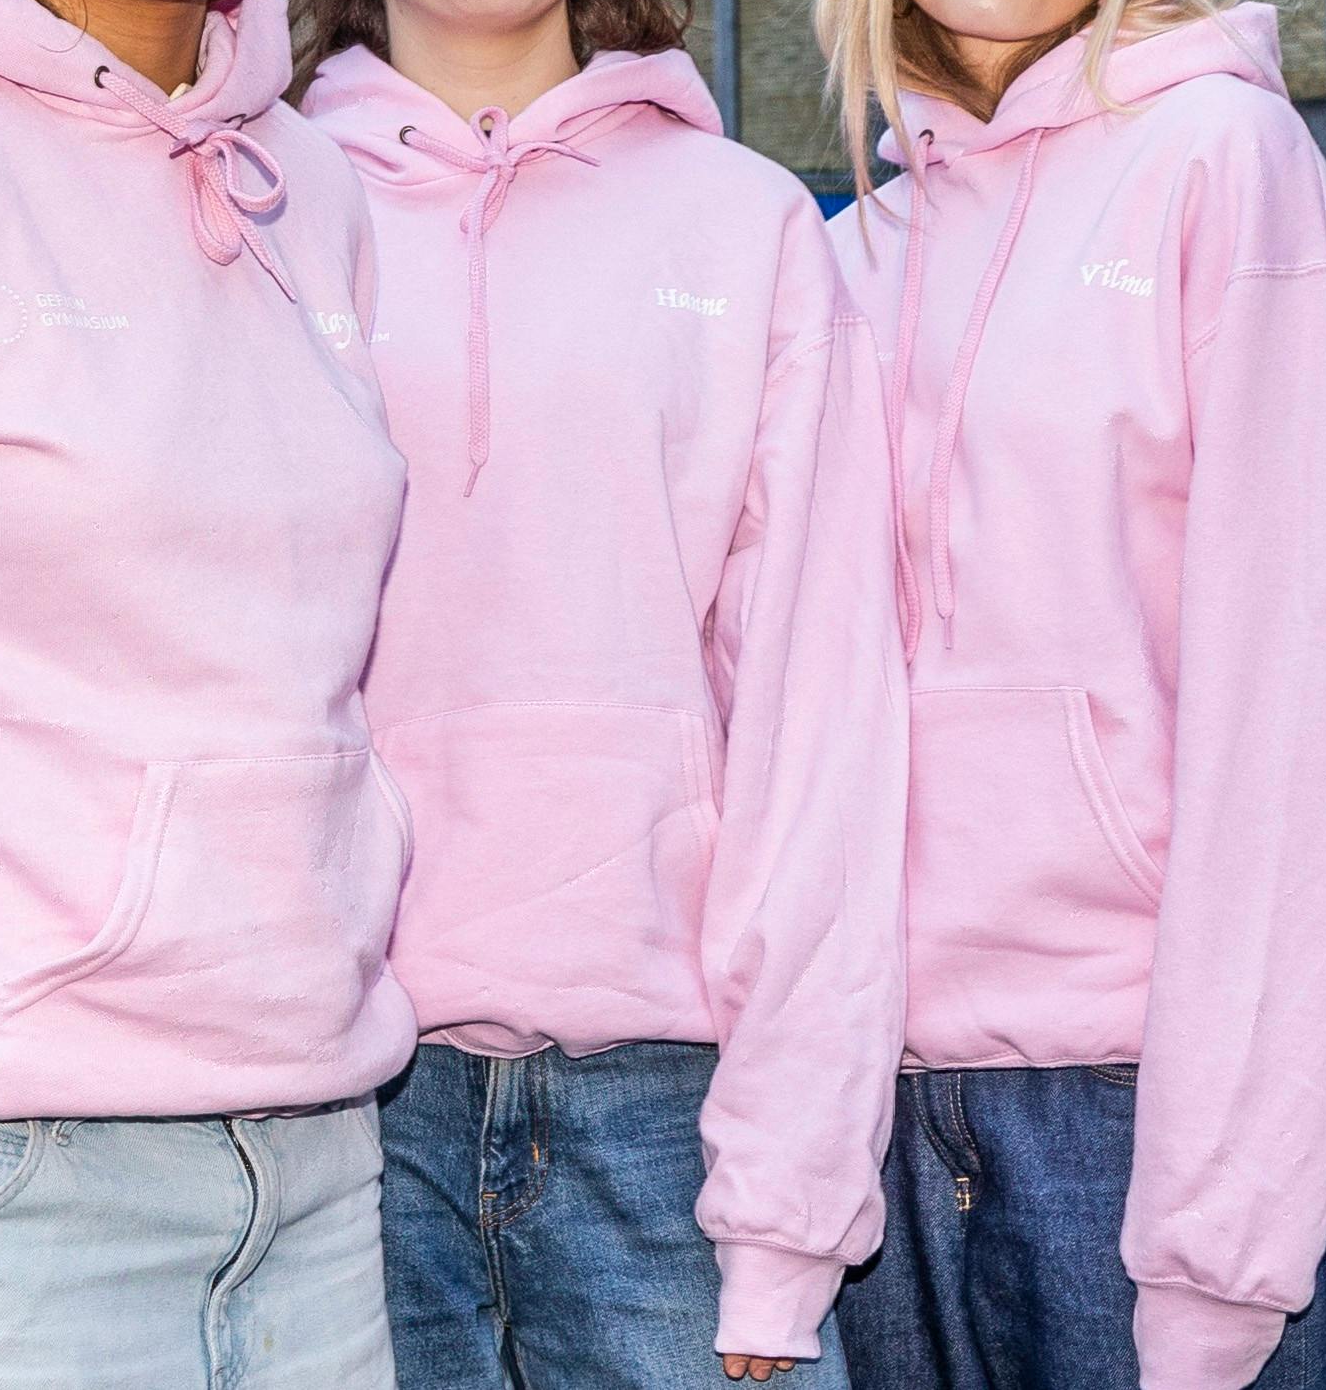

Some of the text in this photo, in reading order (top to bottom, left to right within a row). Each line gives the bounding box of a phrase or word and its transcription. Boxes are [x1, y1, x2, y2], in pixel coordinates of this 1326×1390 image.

[1079, 258, 1154, 298] Vilma
[655, 288, 728, 316] Hanne
[41, 312, 130, 331] GYMNASIUM
